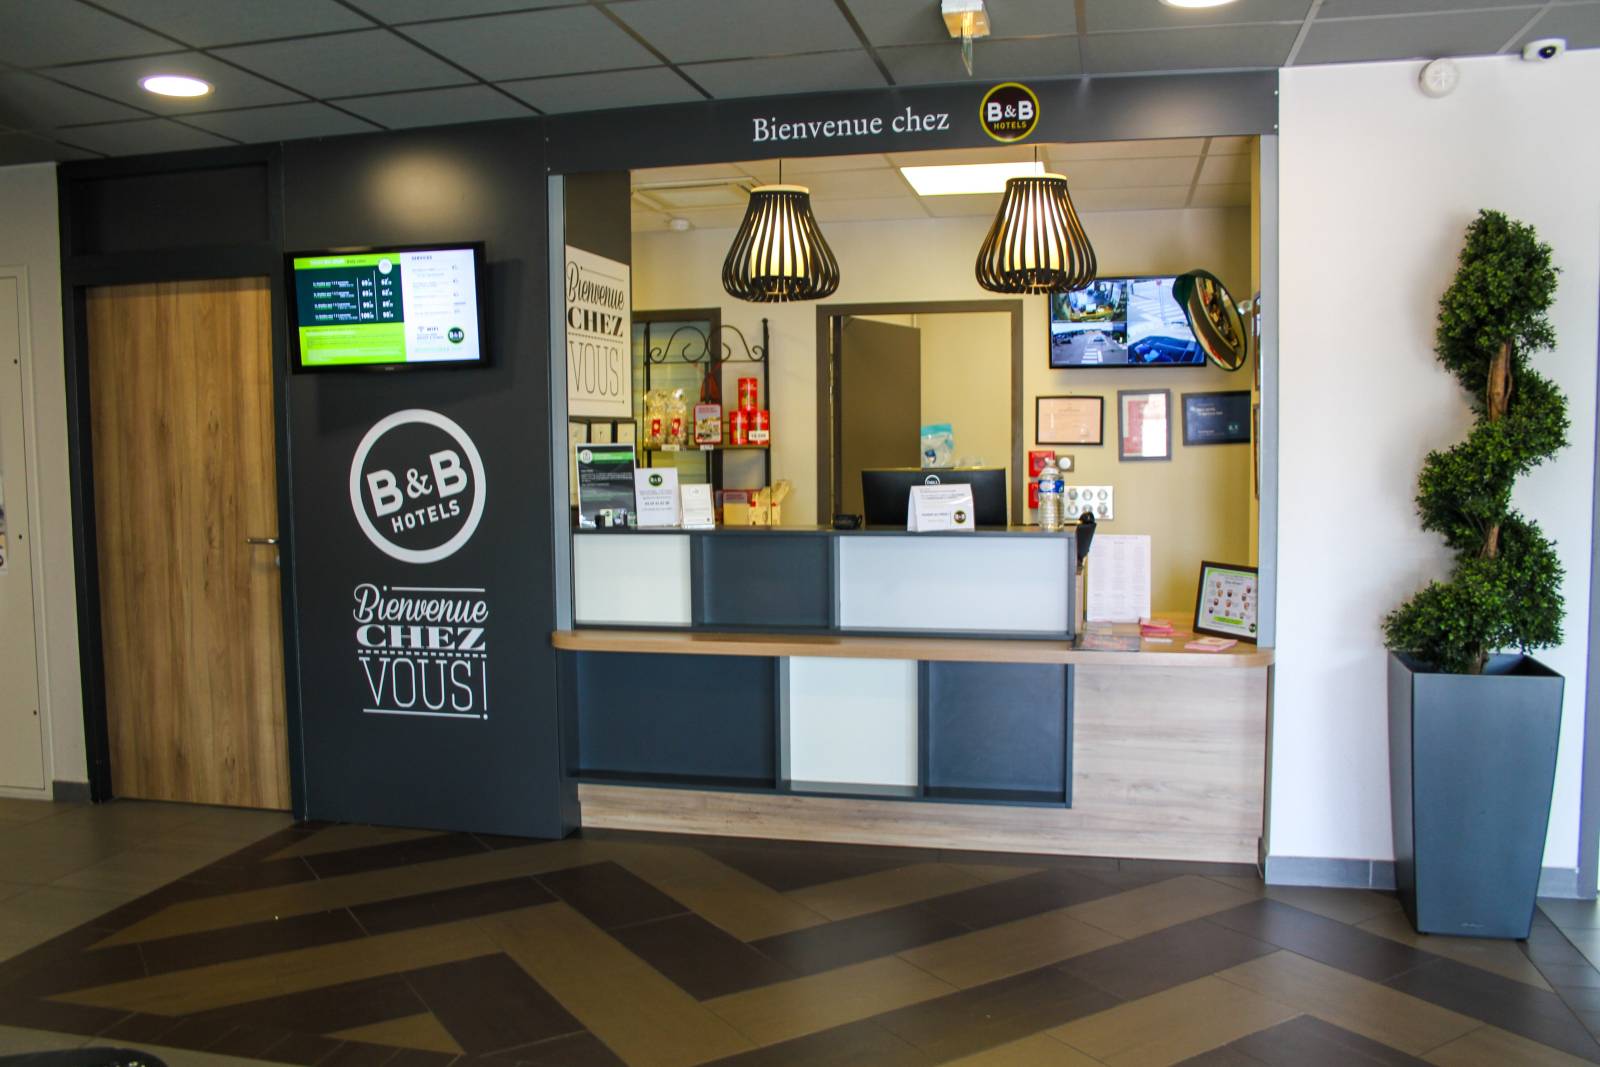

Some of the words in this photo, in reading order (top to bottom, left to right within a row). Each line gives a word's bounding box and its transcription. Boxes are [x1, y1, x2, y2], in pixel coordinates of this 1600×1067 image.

[752, 117, 882, 142] Bienvenue
[892, 107, 949, 133] chez
[987, 100, 1034, 122] B&B
[993, 120, 1027, 131] HOTELS
[567, 261, 624, 311] Bienvenue
[568, 306, 623, 337] CHEZ
[366, 449, 468, 518] B&B
[391, 499, 460, 534] HOTELS
[353, 583, 488, 624] Bienvenue
[356, 623, 486, 651] CHEZ
[358, 656, 488, 720] VOUS!
